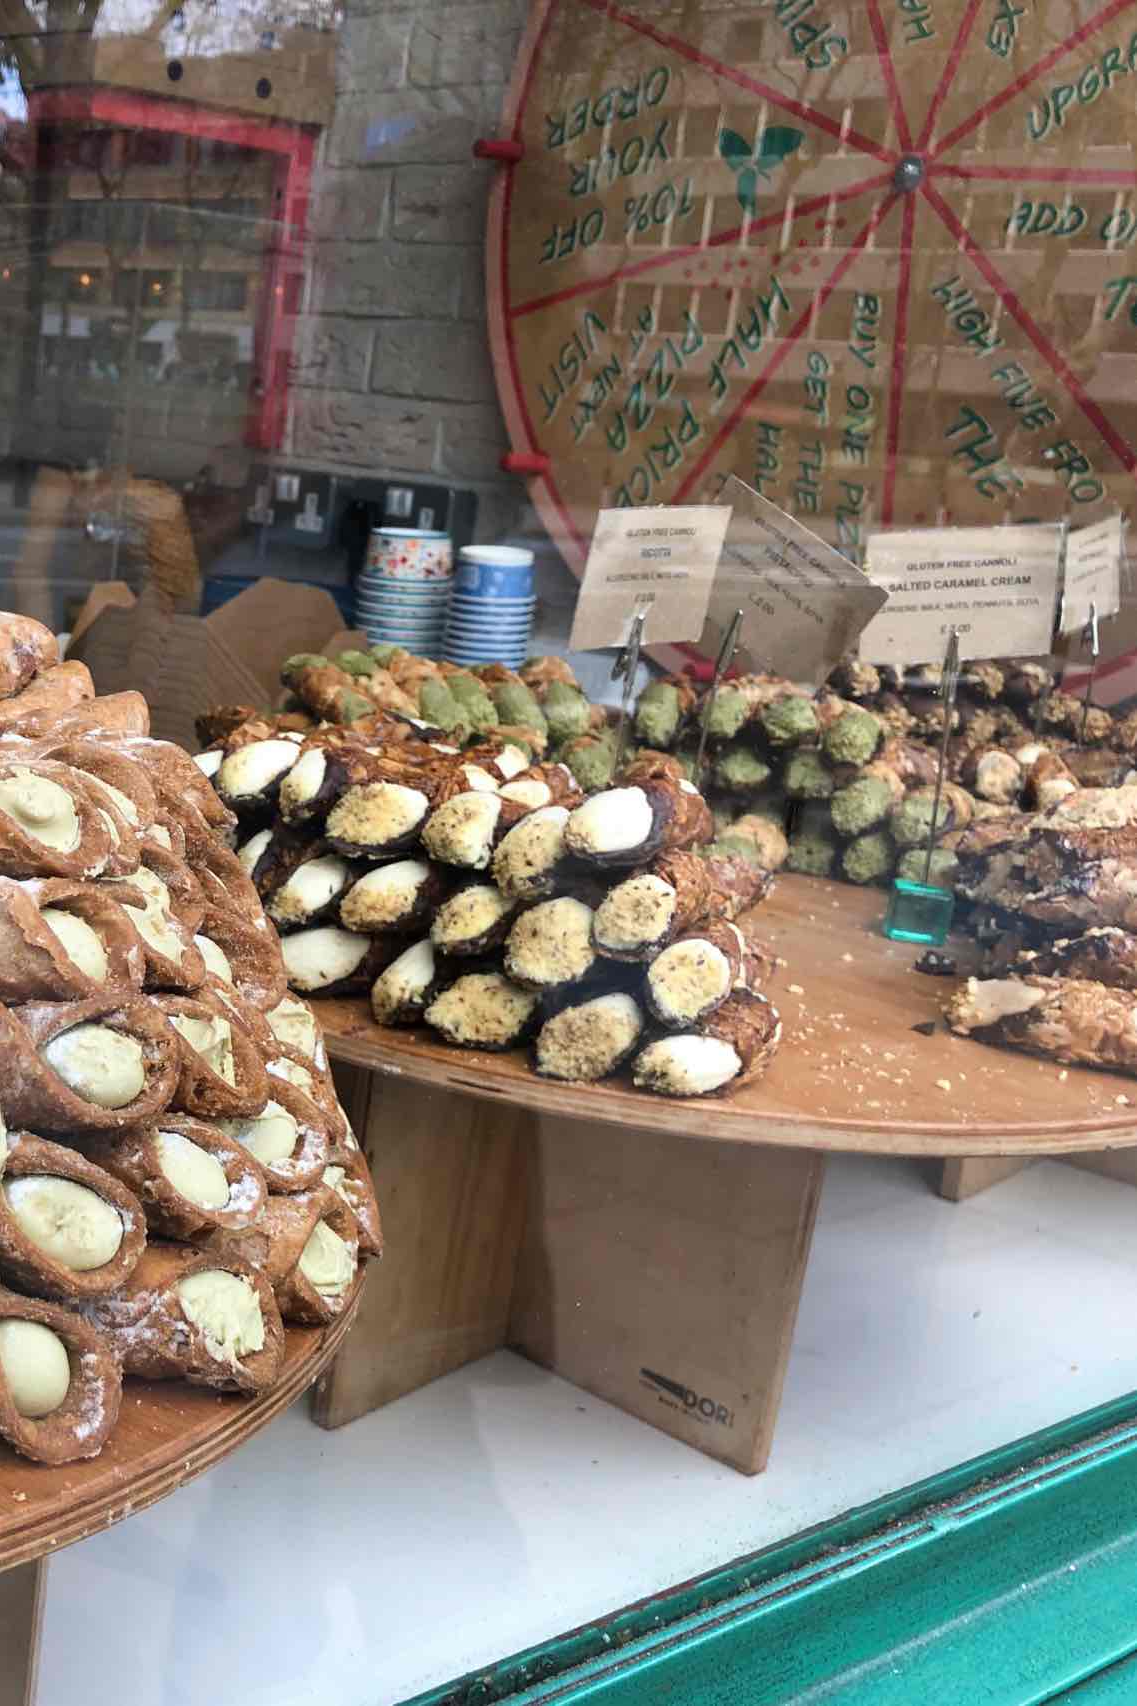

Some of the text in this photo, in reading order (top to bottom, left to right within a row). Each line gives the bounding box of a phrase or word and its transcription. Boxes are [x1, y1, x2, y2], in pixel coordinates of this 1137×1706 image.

[545, 66, 669, 149] ORDER
[569, 120, 669, 196] YOUR
[539, 208, 603, 264] OFF
[1005, 201, 1085, 236] ADD
[541, 311, 606, 418] VISIT
[709, 275, 790, 402] HALF
[849, 291, 878, 368] BUY
[571, 351, 621, 437] NEXT
[606, 312, 703, 451] PIZZA
[932, 275, 1004, 350] HIGH
[991, 361, 1056, 430] FIVE
[1042, 440, 1104, 504] FRO
[753, 421, 782, 494] HAL
[797, 352, 828, 512] GET THE
[844, 385, 870, 464] ONE
[945, 406, 1023, 498] THE
[888, 575, 1031, 593] SALTED CARAMEL CREAM
